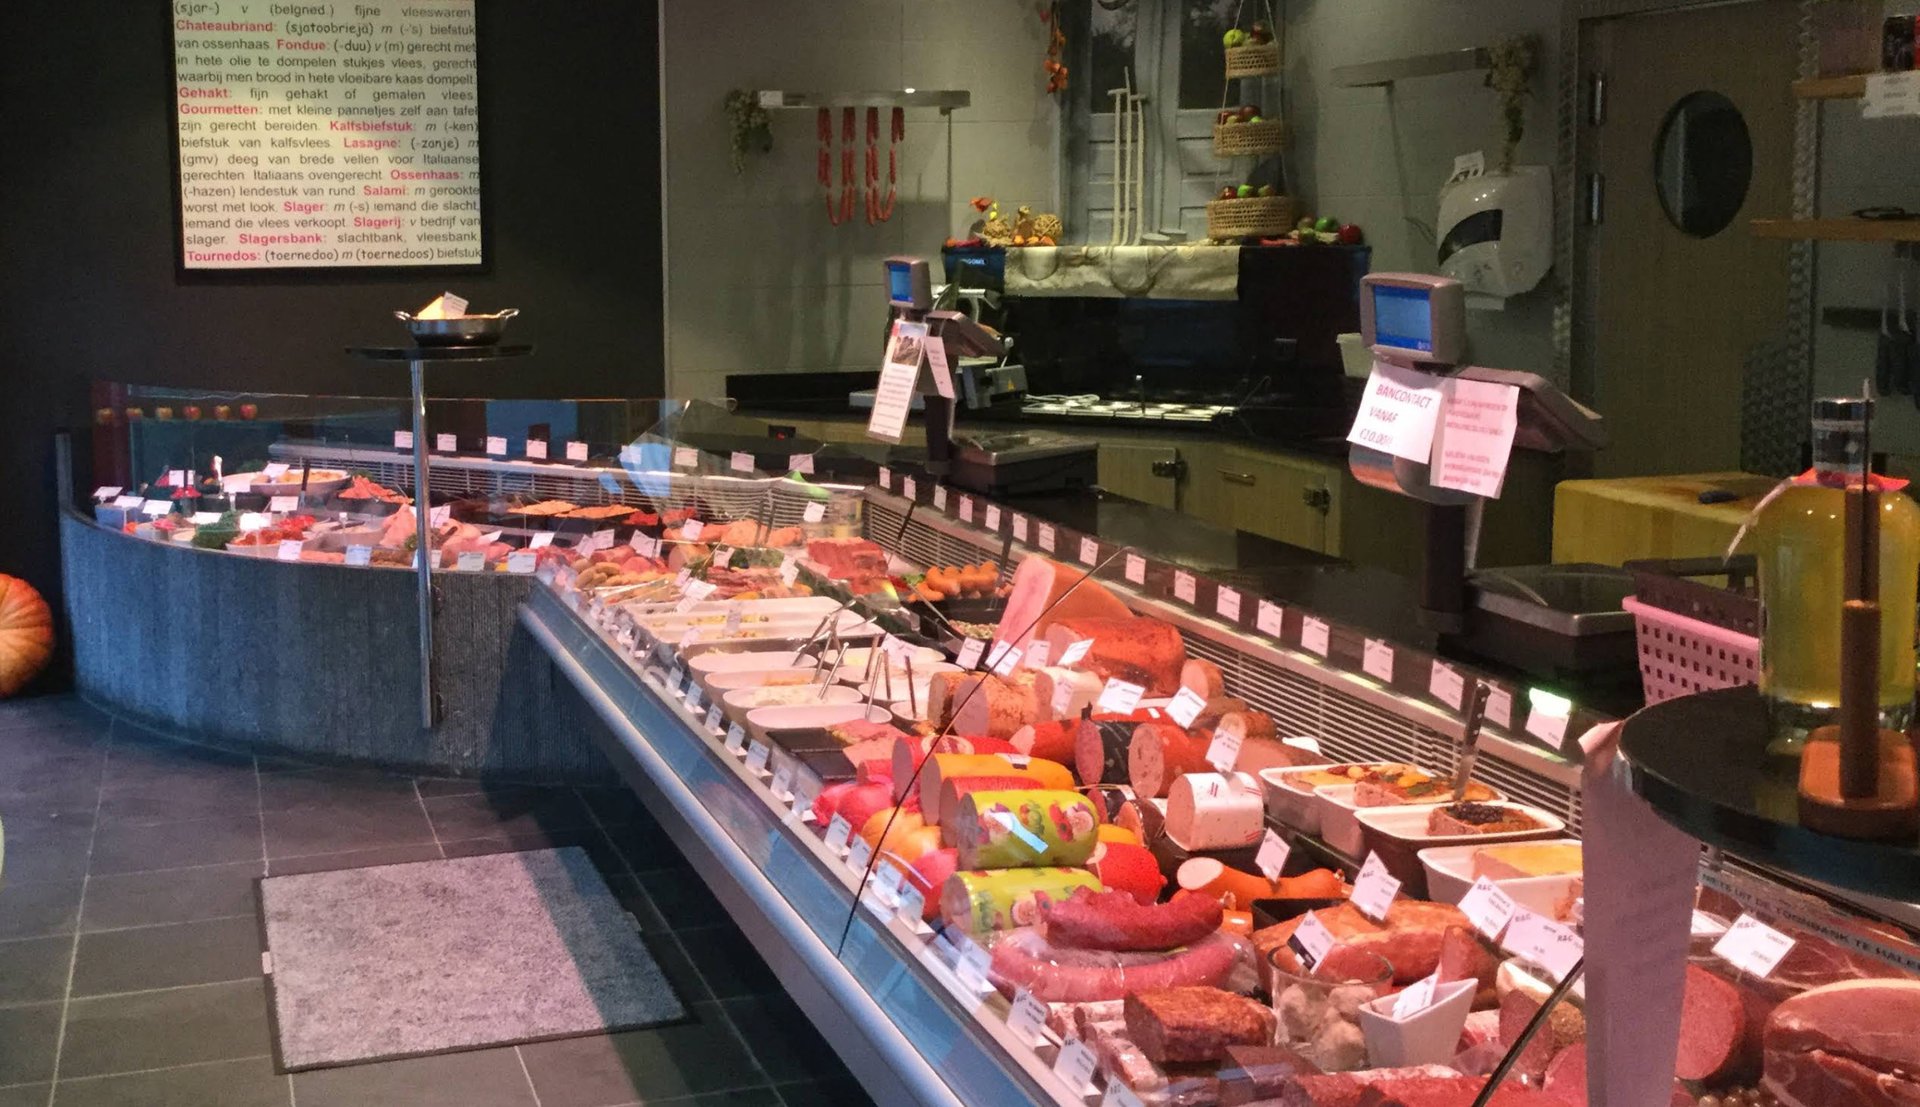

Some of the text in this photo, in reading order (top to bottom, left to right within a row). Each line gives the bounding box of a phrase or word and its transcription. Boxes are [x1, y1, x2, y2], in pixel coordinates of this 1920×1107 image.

[355, 4, 380, 19] fijne
[176, 20, 276, 32] Chateaubriand:
[430, 23, 476, 35] biefstuk
[177, 39, 199, 48] van
[277, 38, 329, 50] Fondue:
[384, 40, 404, 55] (m)
[407, 41, 451, 55] gerecht
[454, 41, 477, 53] met
[177, 54, 188, 66] in
[195, 54, 222, 66] hete
[229, 54, 251, 66] olie
[258, 55, 269, 67] te
[277, 55, 336, 70] dompelen
[343, 56, 385, 70] stukjes
[432, 57, 477, 72] gerecht
[177, 70, 222, 85] waarbij
[226, 73, 252, 83] men
[256, 71, 291, 83] brood
[295, 71, 305, 83] in
[308, 71, 335, 84] hete
[338, 72, 392, 84] vloeibare
[395, 72, 424, 84] kaas
[179, 86, 231, 98] Gehakt:
[250, 87, 268, 101] fijn
[286, 87, 328, 102] gehakt
[345, 87, 357, 99] of
[373, 88, 425, 102] gemalen
[180, 103, 262, 115] Gourmetten:
[269, 103, 291, 115] met
[297, 103, 332, 116] kleine
[338, 104, 396, 119] pannetjes
[400, 104, 422, 116] zelf
[426, 107, 448, 116] aan
[180, 119, 201, 134] zijn
[210, 119, 256, 134] gerecht
[330, 120, 416, 132] Kalfsbiefstuk:
[444, 120, 479, 135] (-ken)
[181, 136, 230, 148] biefstuk
[239, 139, 261, 148] van
[344, 136, 400, 151] Lasagne:
[182, 152, 480, 167] (gmv) deeg van brede vellen voor Italiaanse
[254, 168, 304, 180] Italiaans
[390, 168, 463, 180] Ossenhaas:
[184, 185, 235, 200] (-hazen)
[240, 185, 298, 197] lendestuk
[303, 187, 324, 197] van
[364, 184, 409, 196] Salami:
[430, 184, 480, 199] gerookte
[184, 200, 217, 212] worst
[223, 200, 245, 212] met
[284, 200, 327, 214] Slager:
[350, 199, 369, 214] (-s)
[374, 199, 416, 211] iemand
[421, 199, 438, 211] die
[185, 216, 230, 228] iemand
[235, 216, 253, 228] die
[258, 215, 289, 228] vlees
[354, 215, 404, 230] Slagerij:
[420, 214, 456, 229] bedrijf
[460, 217, 481, 226] van
[239, 231, 326, 246] Slagersbank:
[187, 249, 260, 261] Tournedos:
[356, 247, 434, 261] (toernedoos)
[437, 246, 482, 258] biefstuk
[1375, 384, 1433, 408] BANCONTACT
[1369, 406, 1399, 423] VANAF
[1856, 939, 1870, 951] TE
